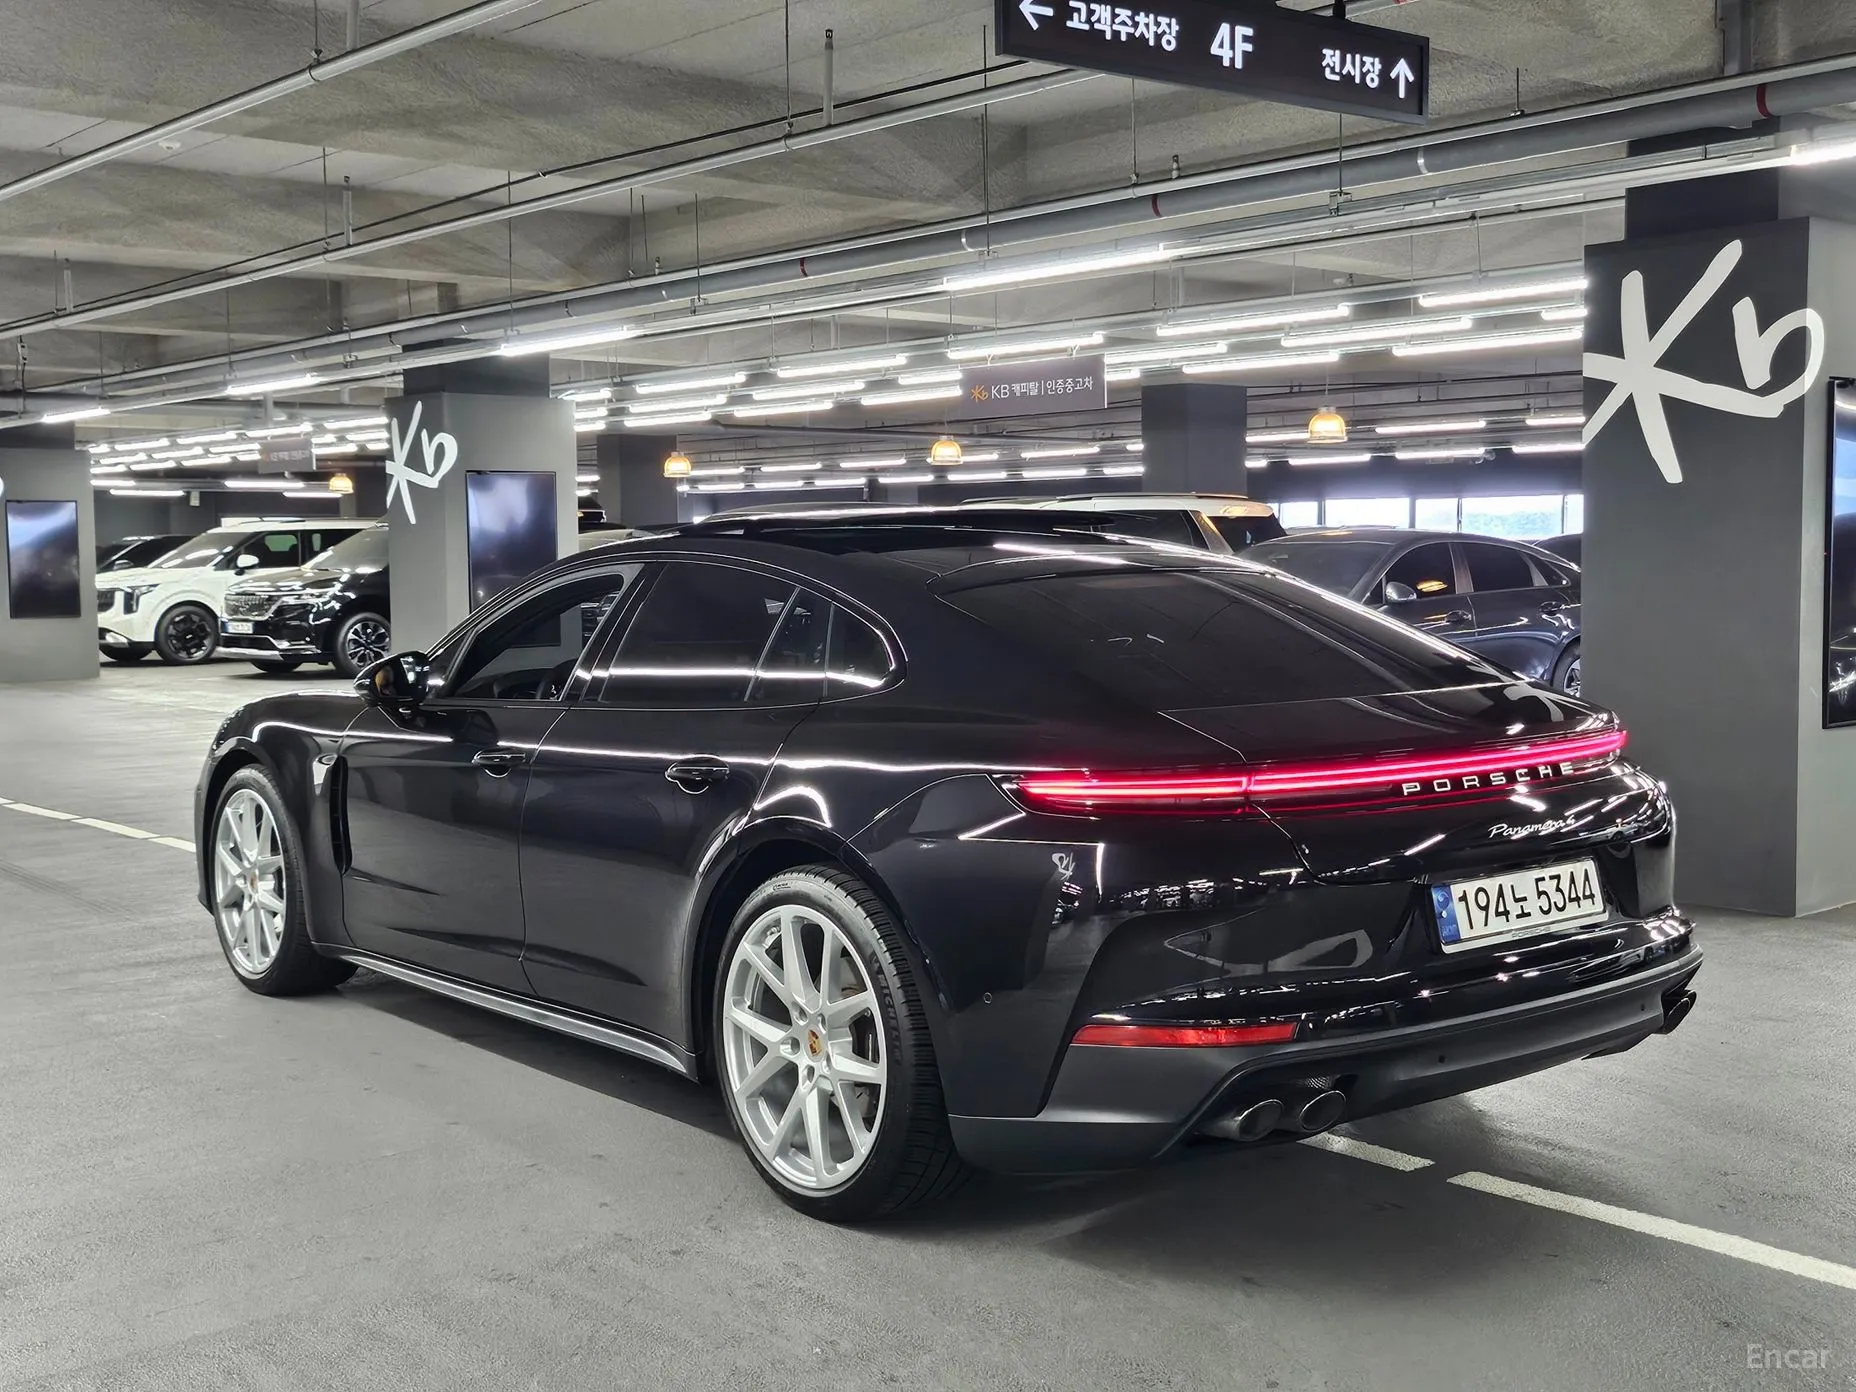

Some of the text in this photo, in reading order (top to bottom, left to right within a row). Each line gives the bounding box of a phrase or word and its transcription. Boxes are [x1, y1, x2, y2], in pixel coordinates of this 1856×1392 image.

[1065, 1, 1382, 90] 고객주차장 4F 전시장
[1046, 375, 1094, 395] 인증중고차
[1402, 761, 1574, 796] PORSCHE
[1487, 819, 1566, 839] Panamera
[1457, 867, 1597, 930] 194노 5344
